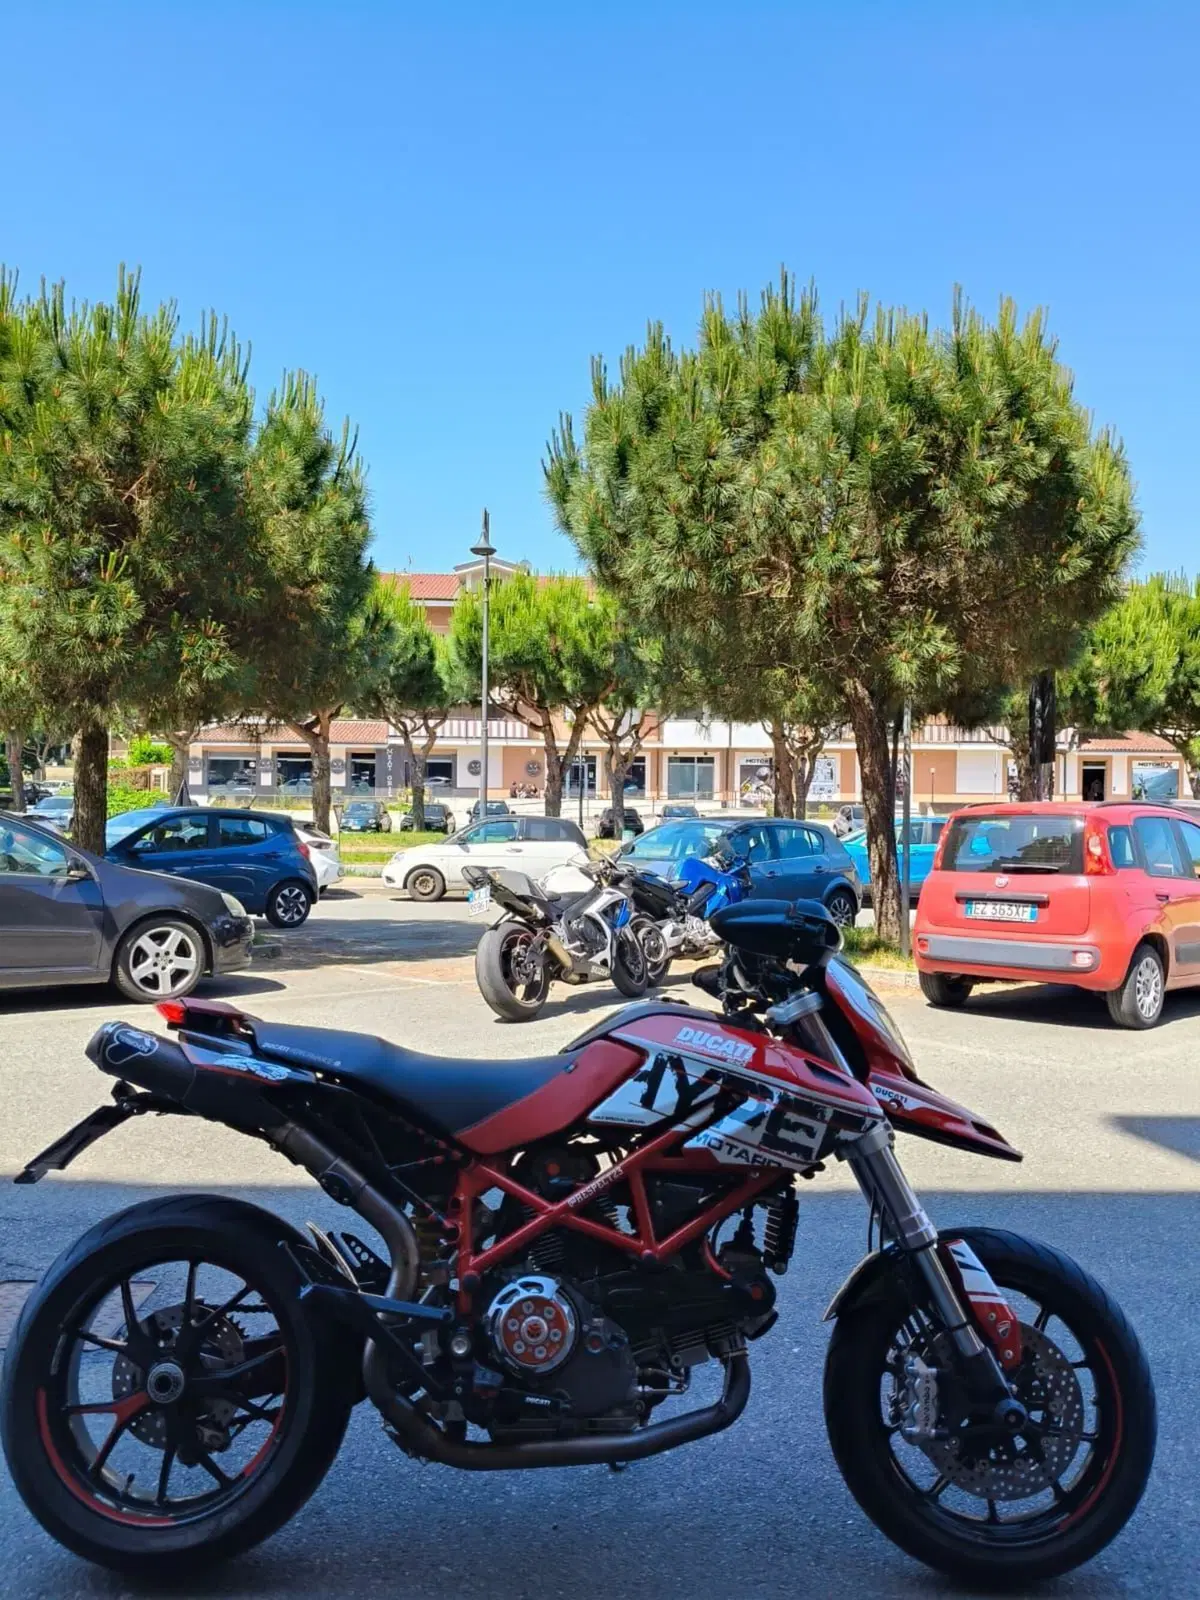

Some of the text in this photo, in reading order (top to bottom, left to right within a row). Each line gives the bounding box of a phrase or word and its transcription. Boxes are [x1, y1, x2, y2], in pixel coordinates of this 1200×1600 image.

[974, 902, 988, 915] EZ
[676, 1027, 757, 1060] DUCATI
[875, 1086, 908, 1104] DUCATI
[694, 1132, 783, 1169] MOTARD
